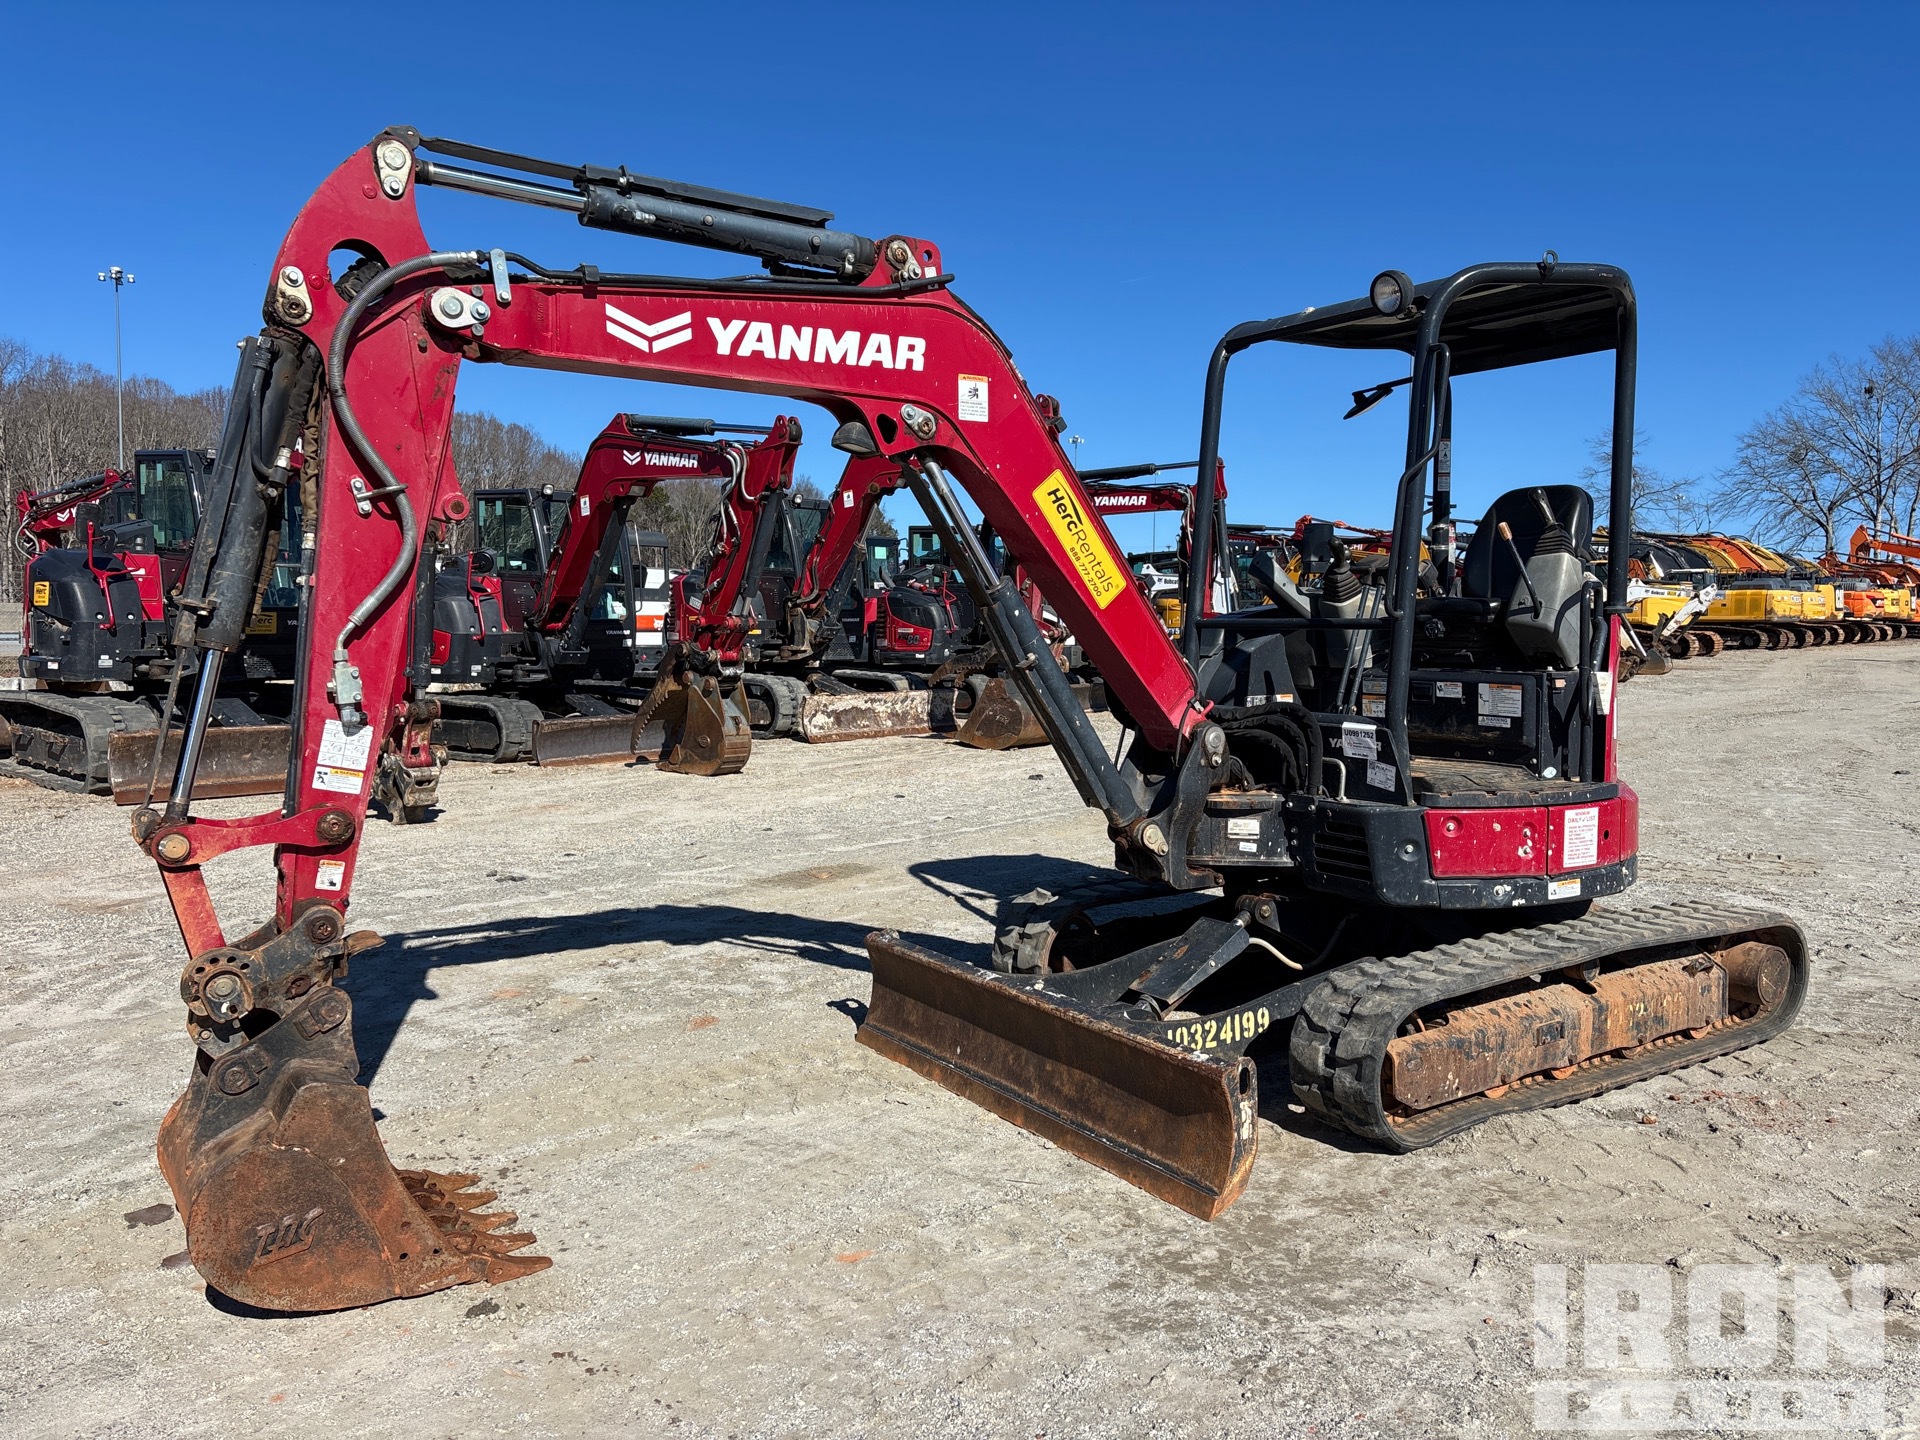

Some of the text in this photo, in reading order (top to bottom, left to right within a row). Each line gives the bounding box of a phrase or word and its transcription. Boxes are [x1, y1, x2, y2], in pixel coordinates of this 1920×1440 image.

[706, 317, 926, 371] YANMAR
[643, 452, 699, 468] YANMAR
[1093, 495, 1147, 507] YANMAR
[1069, 546, 1102, 597] 888-777-2700
[1329, 737, 1382, 752] YAR
